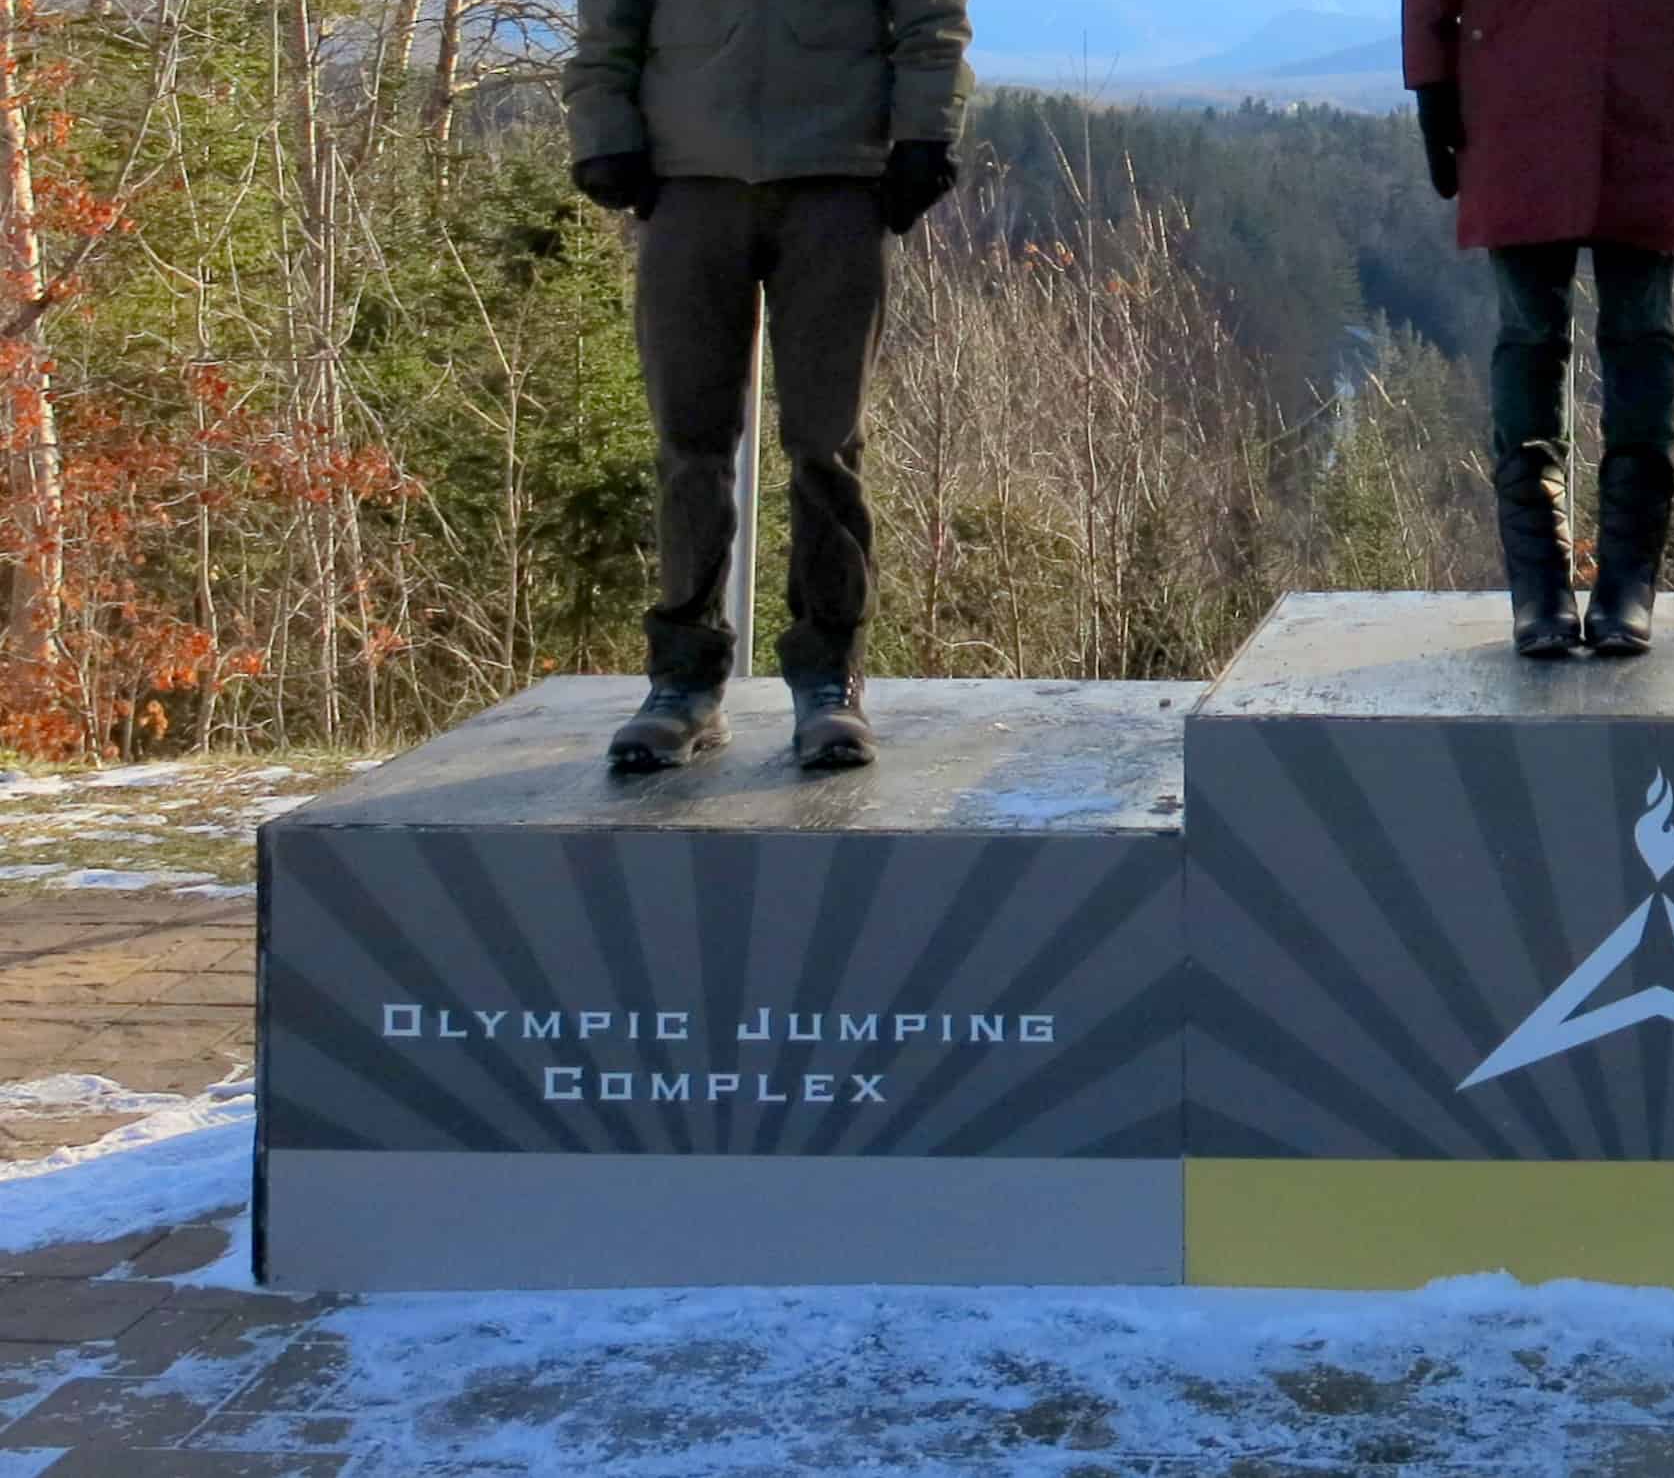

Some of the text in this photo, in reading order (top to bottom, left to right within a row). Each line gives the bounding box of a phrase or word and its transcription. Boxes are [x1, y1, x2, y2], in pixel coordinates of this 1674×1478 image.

[382, 1003, 1054, 1043] OLYMPIC JUMPING
[543, 1066, 886, 1103] COMPLEX
